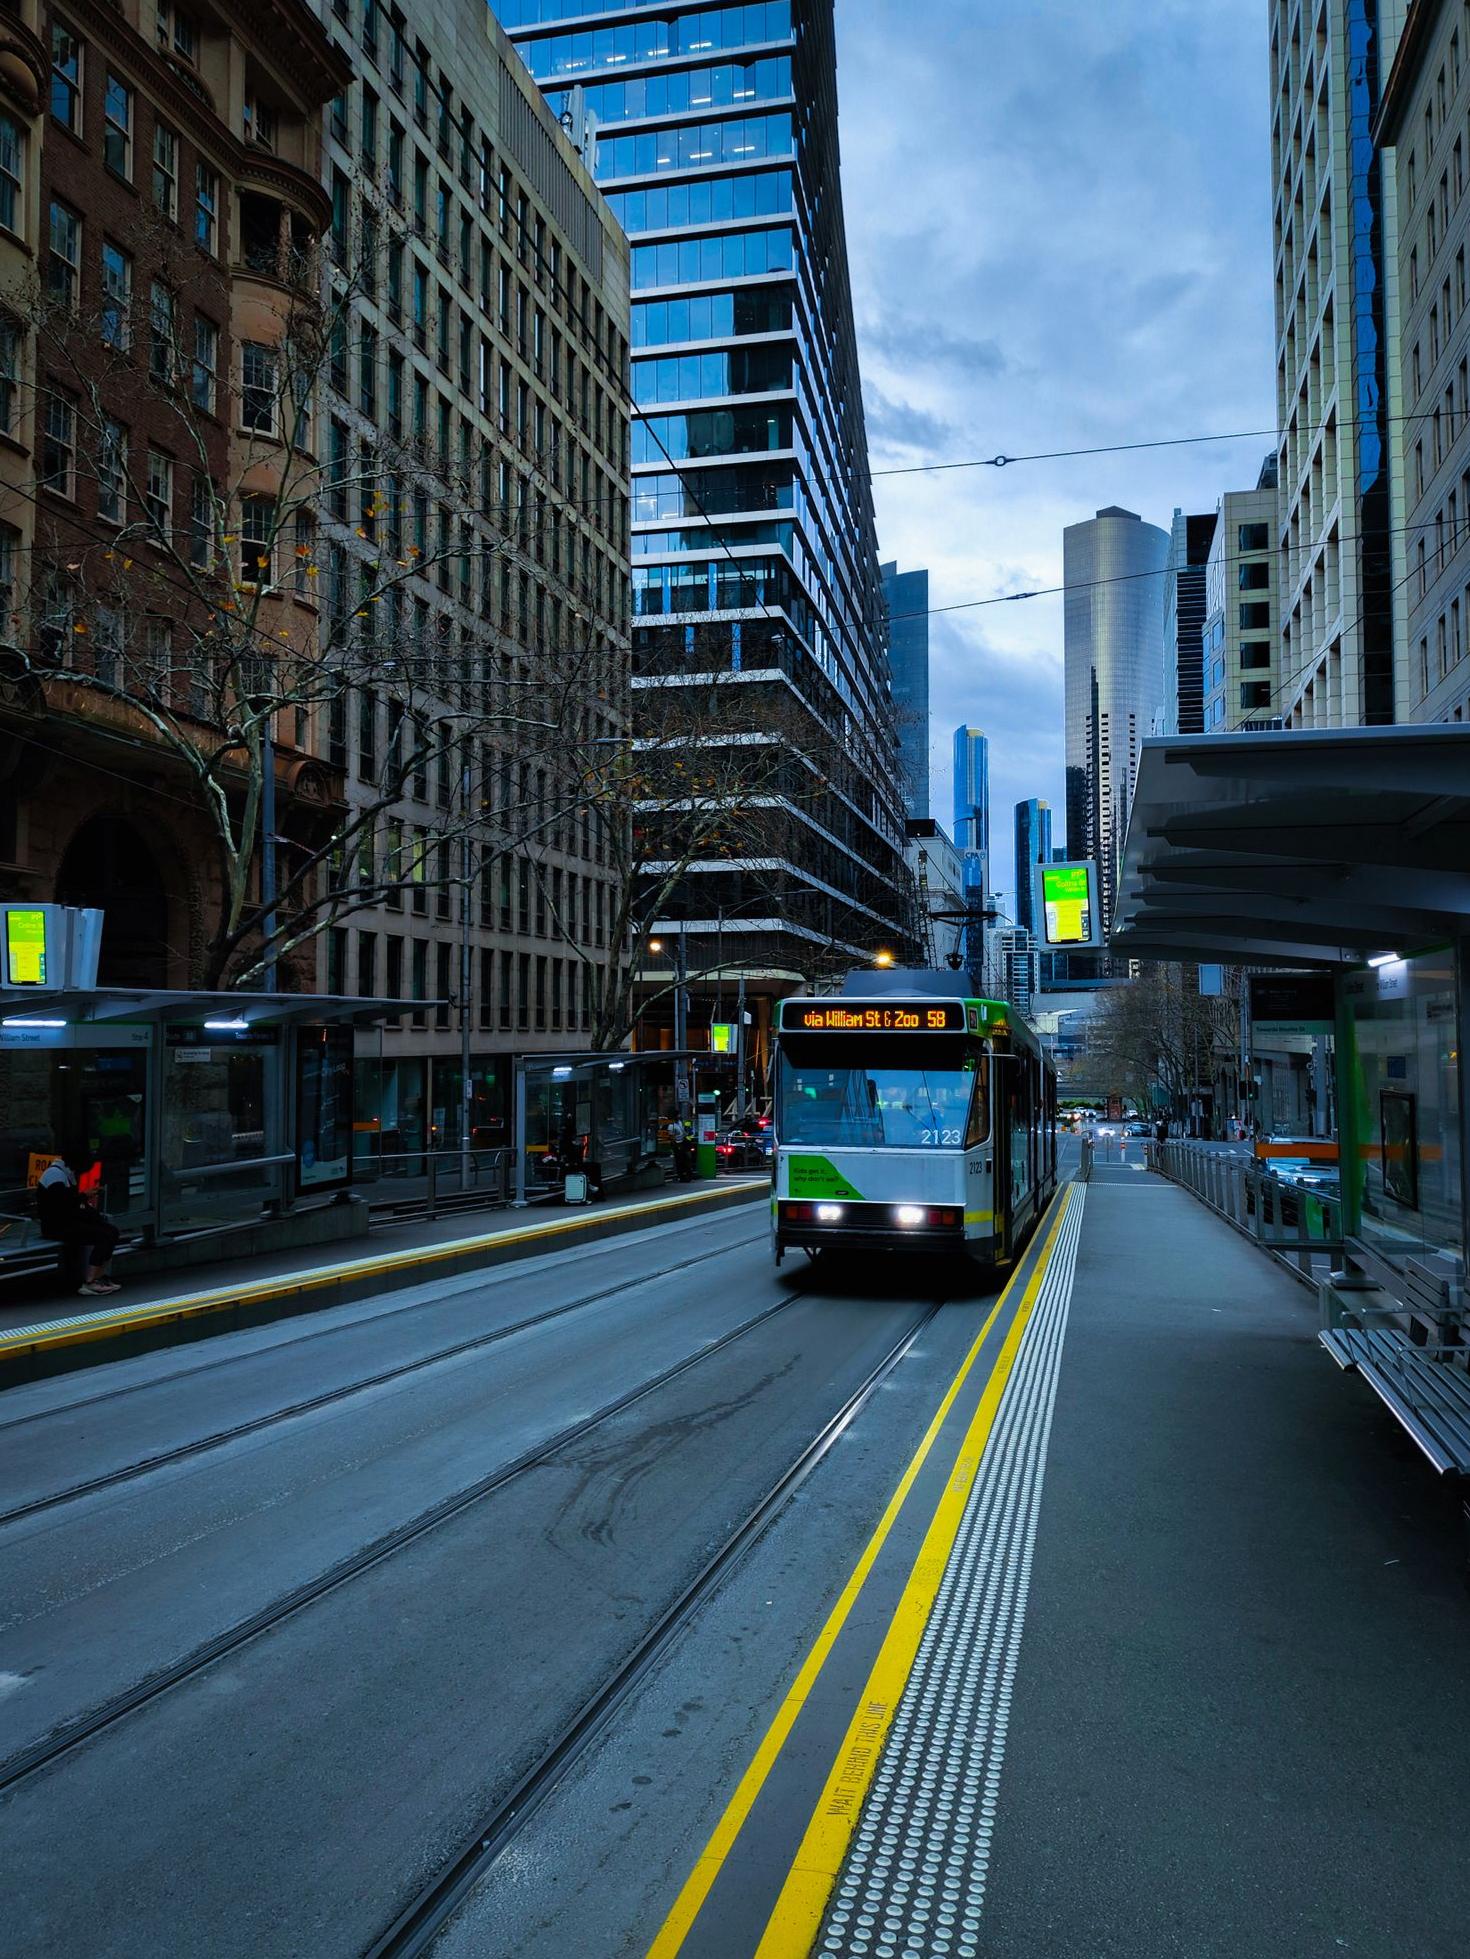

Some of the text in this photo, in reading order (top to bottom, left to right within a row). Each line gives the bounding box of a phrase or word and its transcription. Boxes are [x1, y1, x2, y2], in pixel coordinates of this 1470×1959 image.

[965, 852, 979, 860] CPA
[804, 1011, 946, 1027] via William St & Zoo 58
[722, 1096, 773, 1121] 447
[921, 1129, 961, 1144] 2123
[969, 1161, 983, 1174] 2123
[827, 1701, 888, 1815] WAIT BEHIND THIS LINE
